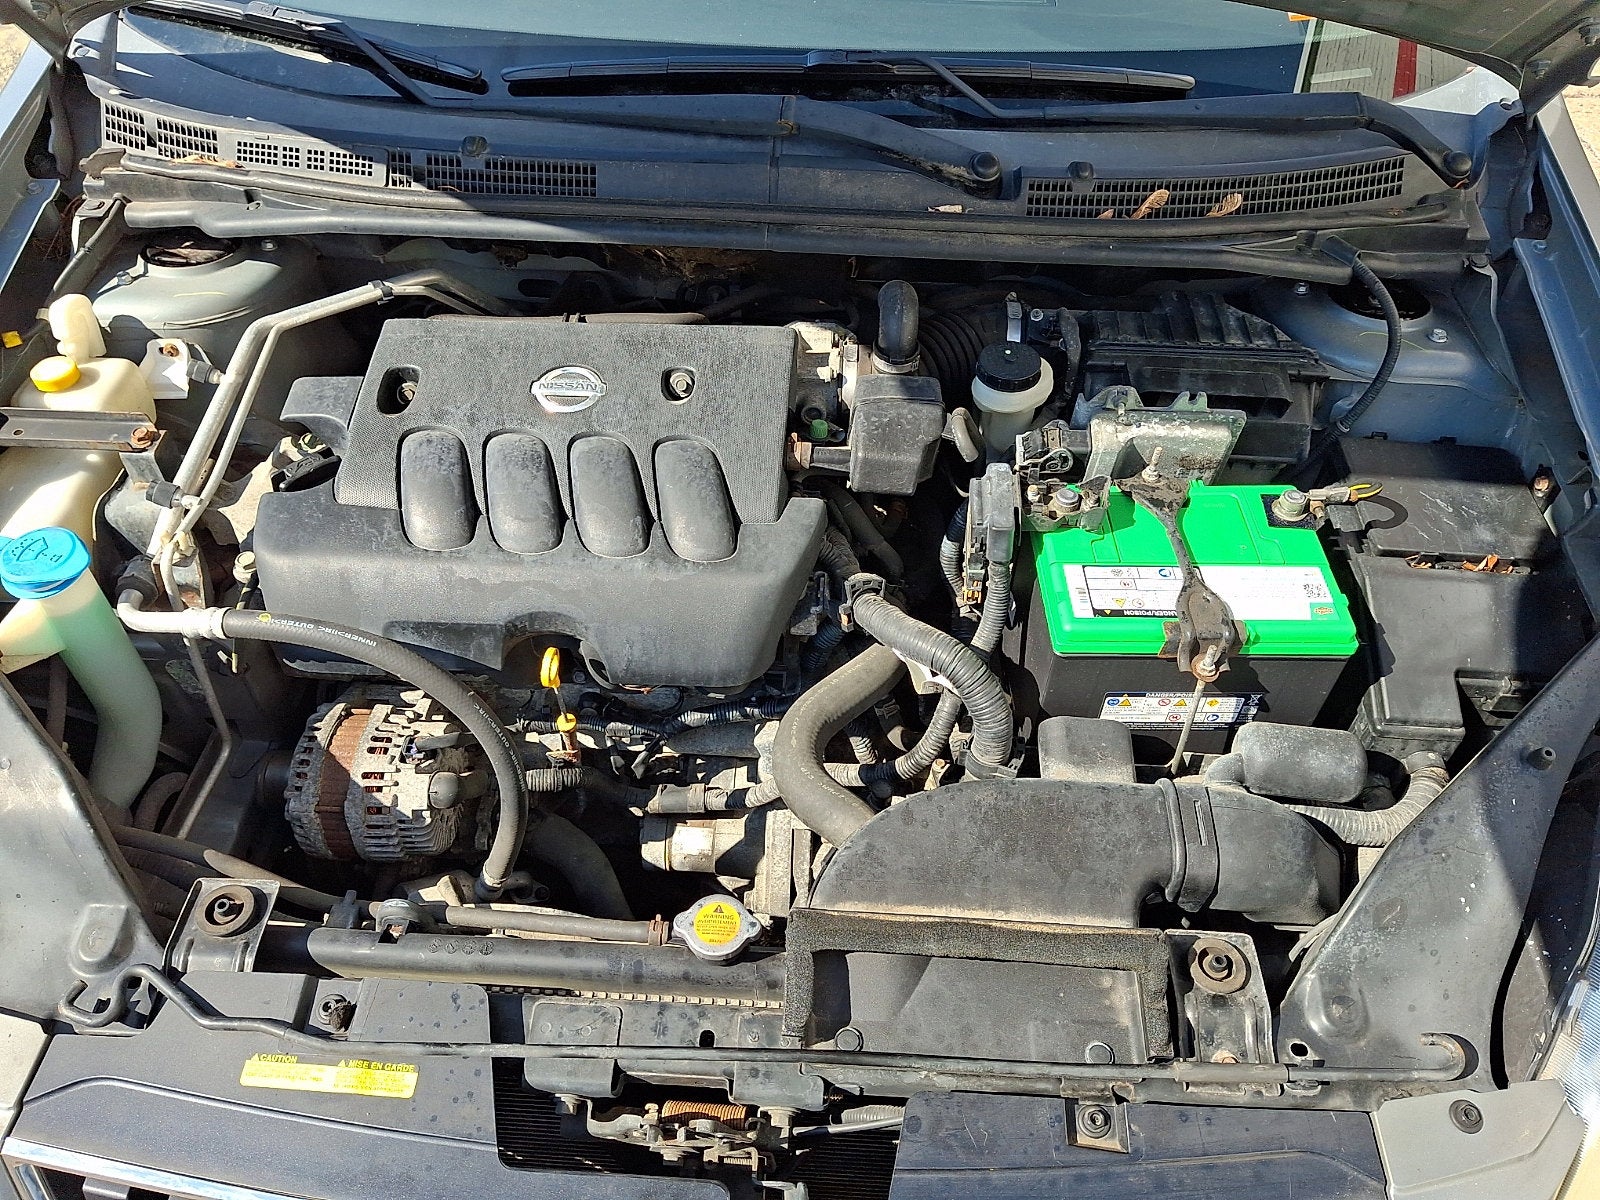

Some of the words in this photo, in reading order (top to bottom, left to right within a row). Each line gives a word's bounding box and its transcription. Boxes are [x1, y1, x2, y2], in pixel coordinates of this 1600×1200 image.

[538, 381, 598, 392] NISSAN
[1124, 609, 1178, 617] ANGER/POISON
[702, 912, 735, 921] WARNING
[260, 1053, 298, 1064] CAUTION
[348, 1058, 371, 1069] MISE
[370, 1060, 384, 1070] EN
[384, 1061, 416, 1073] GARDE
